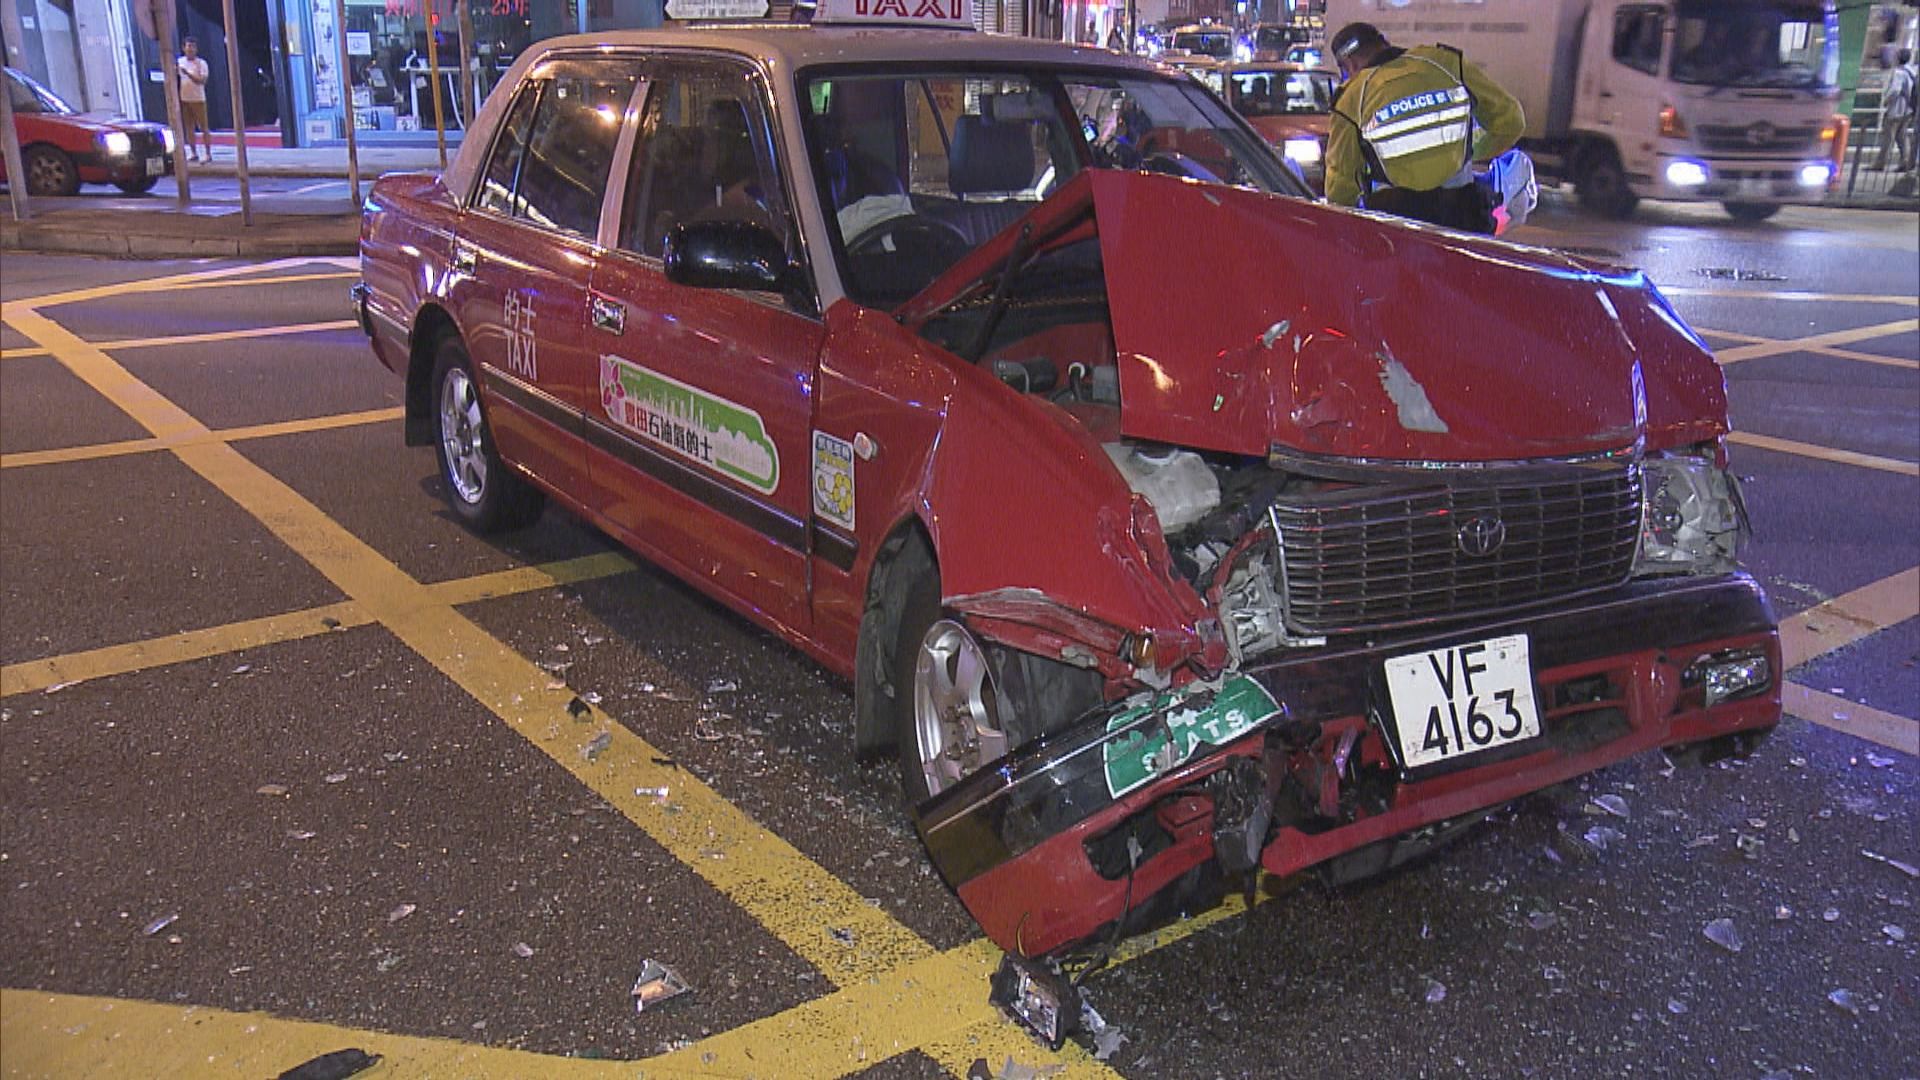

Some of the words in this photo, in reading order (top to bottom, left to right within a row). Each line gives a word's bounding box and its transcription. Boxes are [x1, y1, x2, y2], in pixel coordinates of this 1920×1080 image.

[1391, 94, 1435, 115] POLICE
[504, 288, 537, 335] 的士
[503, 328, 538, 381] TAXI
[1427, 644, 1487, 702] VF
[1141, 708, 1245, 772] SATS
[1422, 688, 1522, 755] 4163
